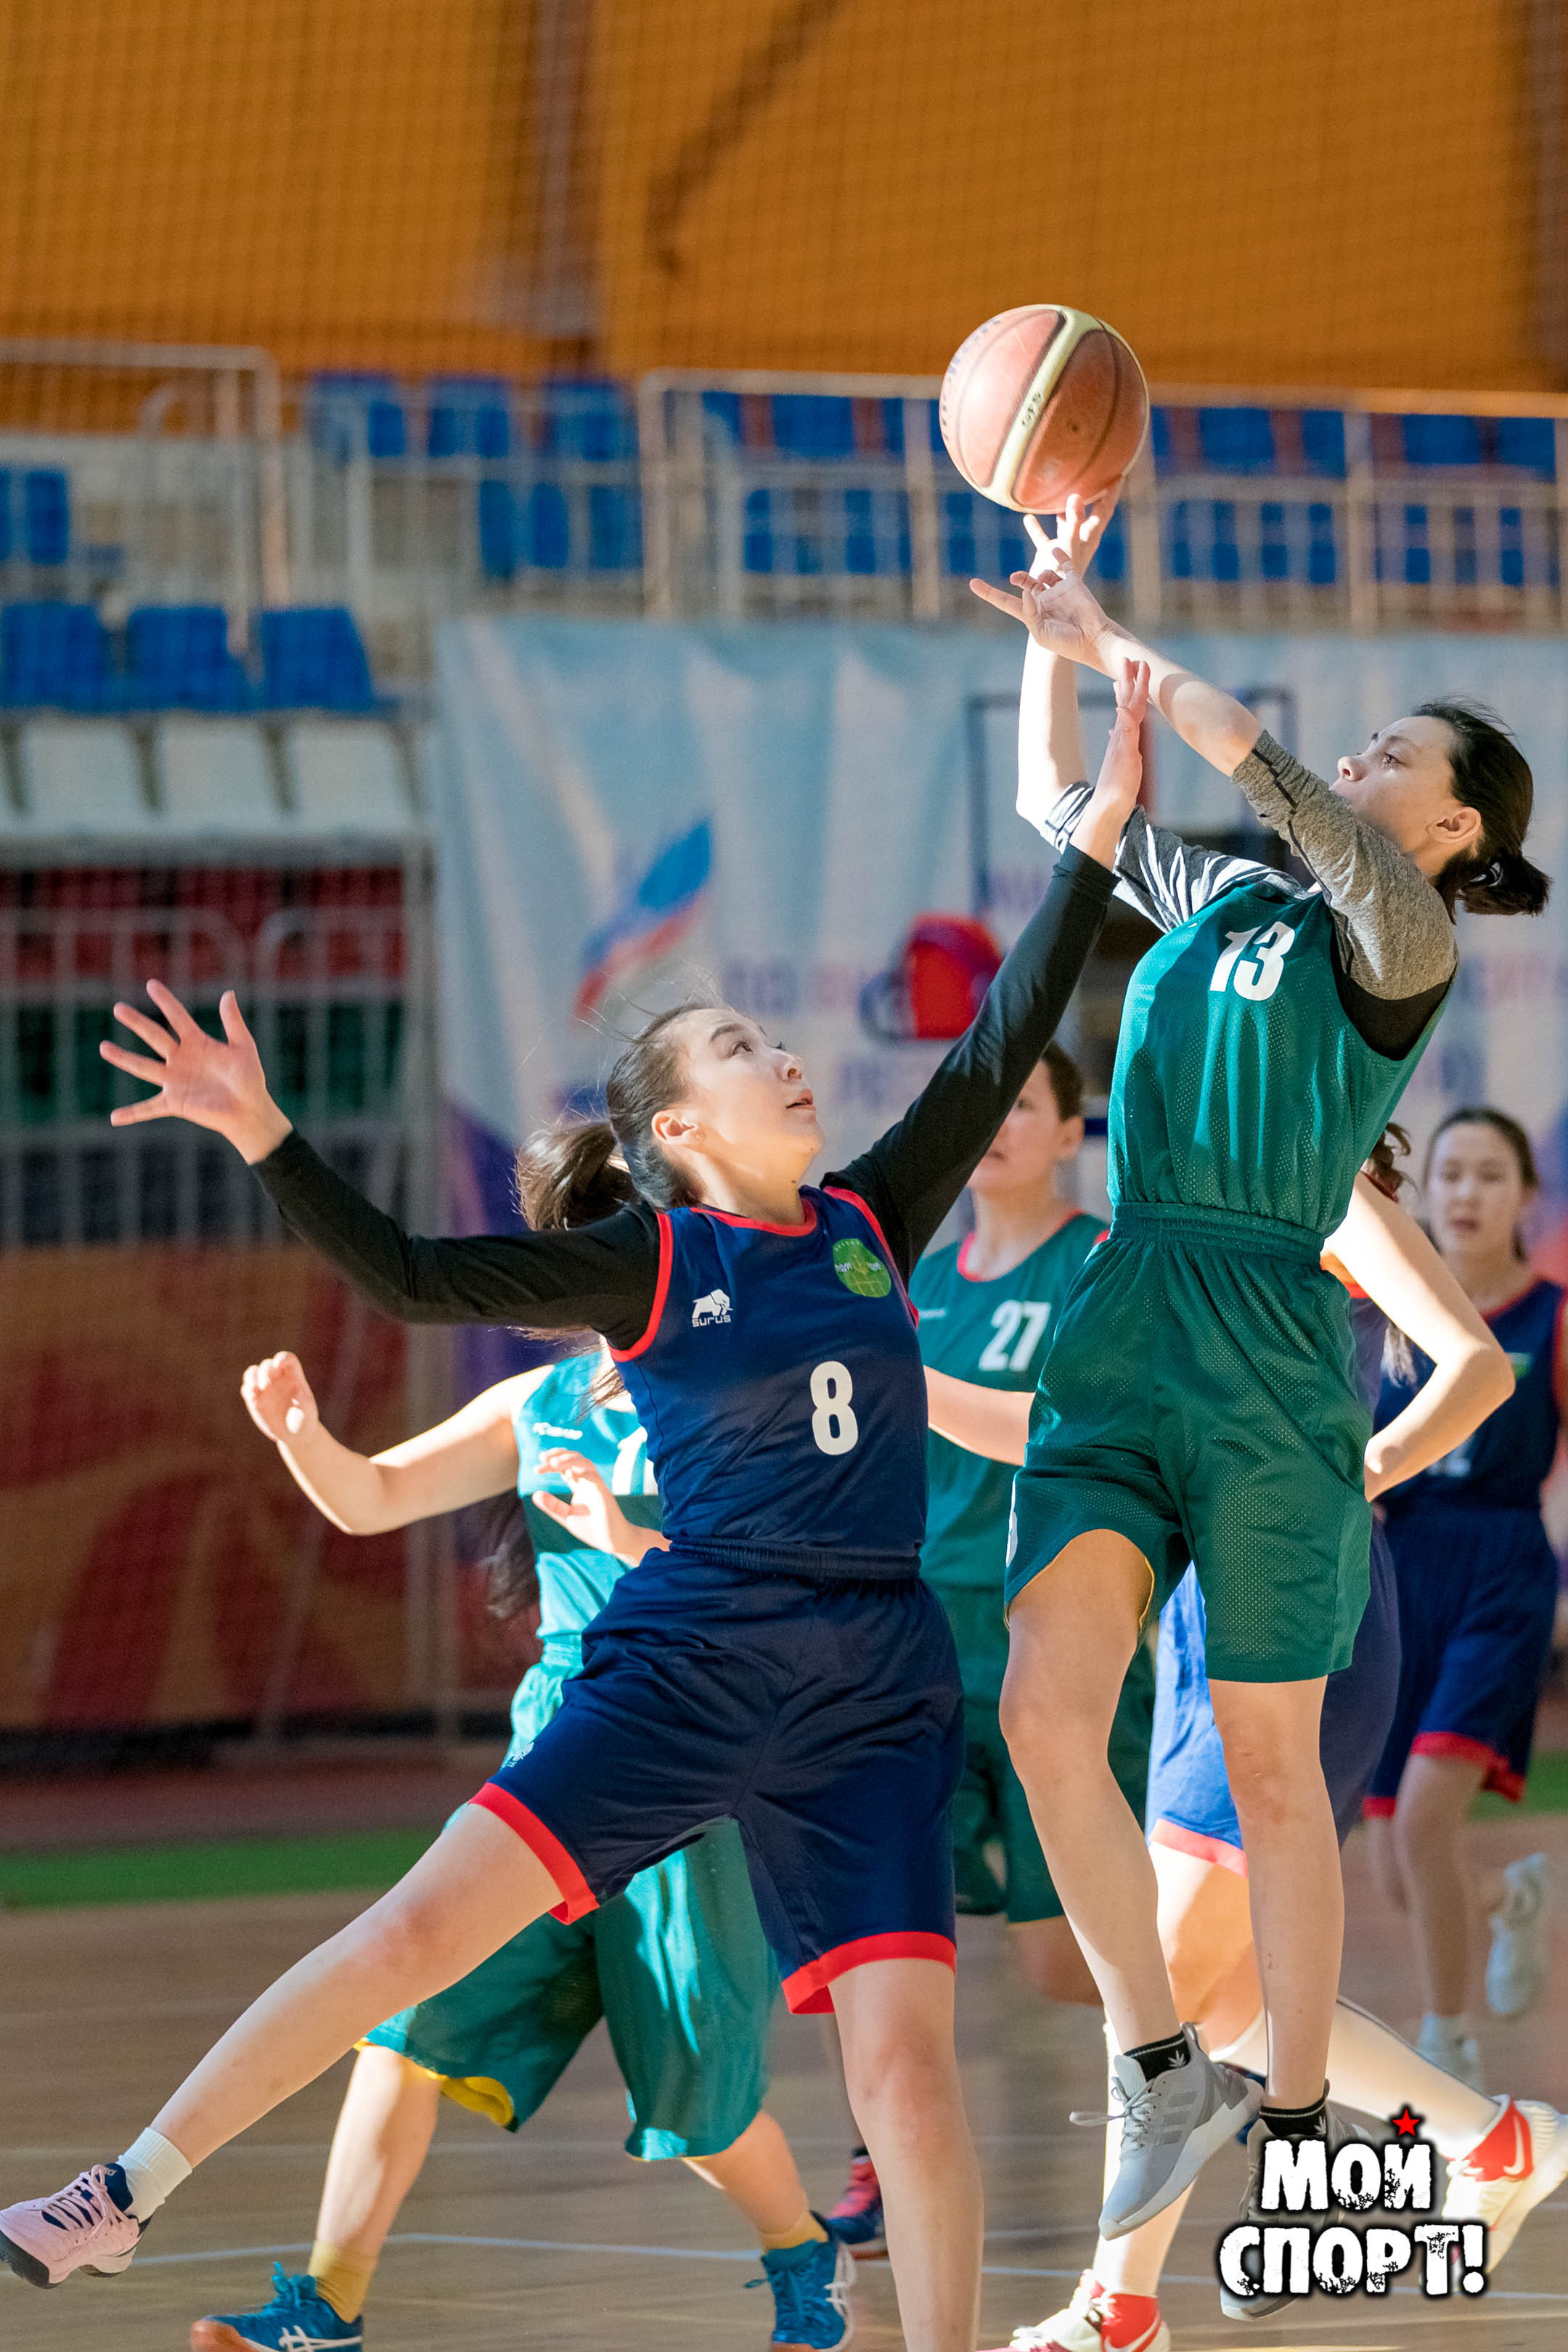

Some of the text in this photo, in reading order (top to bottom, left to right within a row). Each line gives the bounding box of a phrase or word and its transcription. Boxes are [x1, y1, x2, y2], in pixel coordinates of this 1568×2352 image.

[1209, 920, 1296, 1001] 13
[692, 1315, 732, 1328] surus
[978, 1299, 1052, 1371] 27
[809, 1360, 859, 1455] 8
